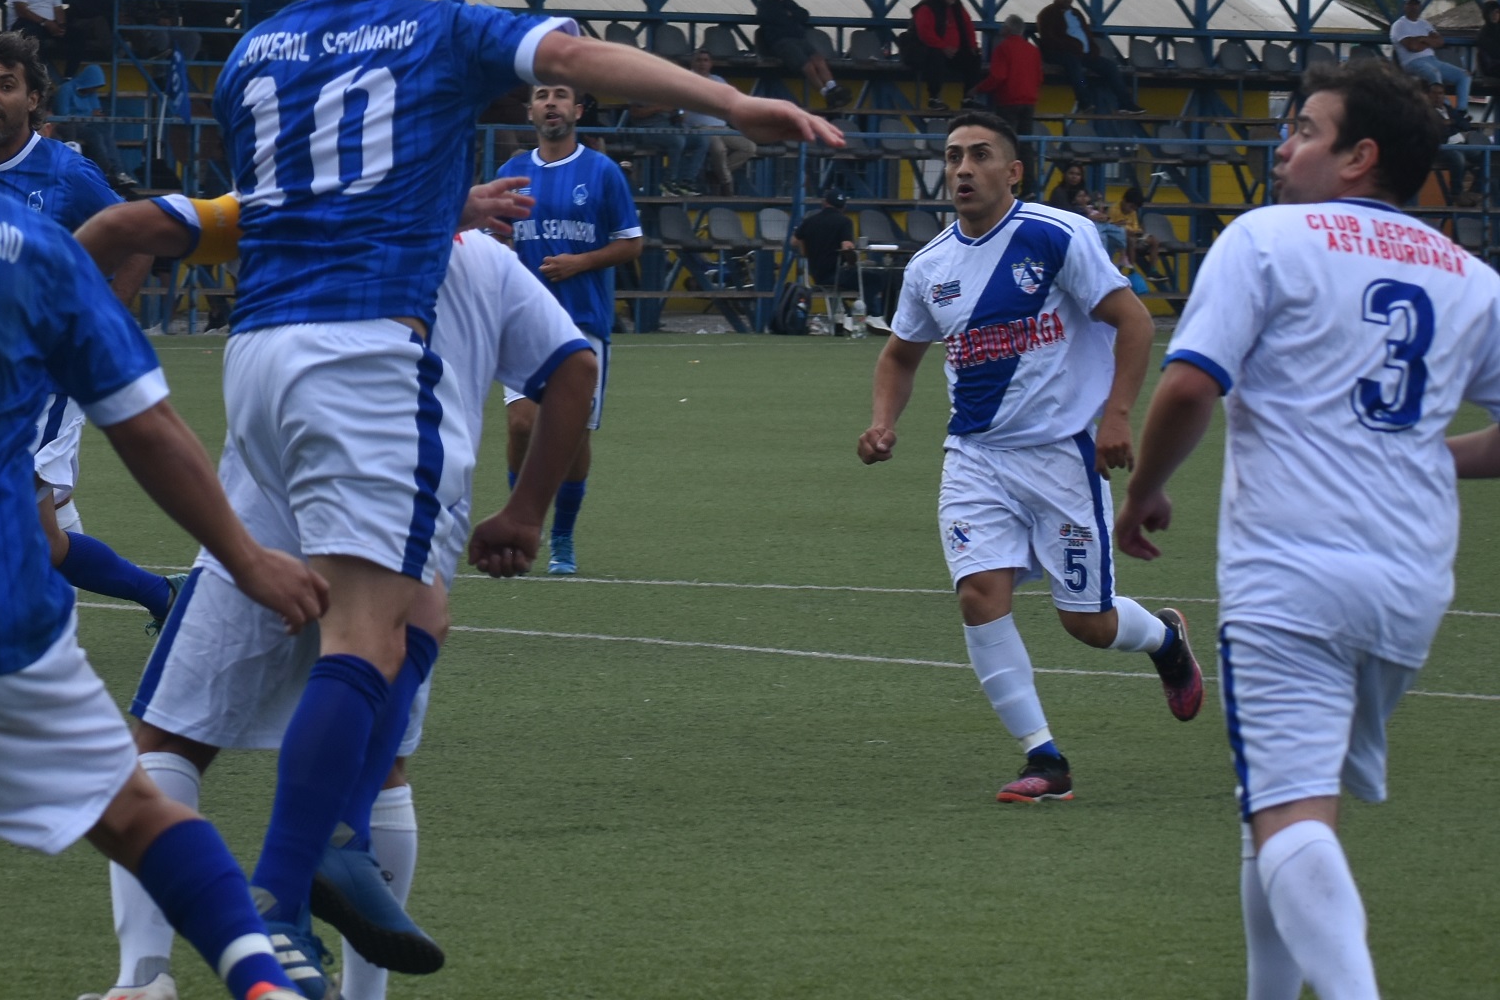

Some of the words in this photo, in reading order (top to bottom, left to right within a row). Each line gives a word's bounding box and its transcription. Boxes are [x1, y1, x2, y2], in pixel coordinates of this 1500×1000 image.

[238, 31, 310, 68] JUVENIL
[241, 65, 398, 207] 10
[1306, 213, 1362, 234] CLUB
[1327, 231, 1466, 278] ASTABURUAGA
[1351, 278, 1436, 432] 3
[1063, 547, 1088, 594] 5
